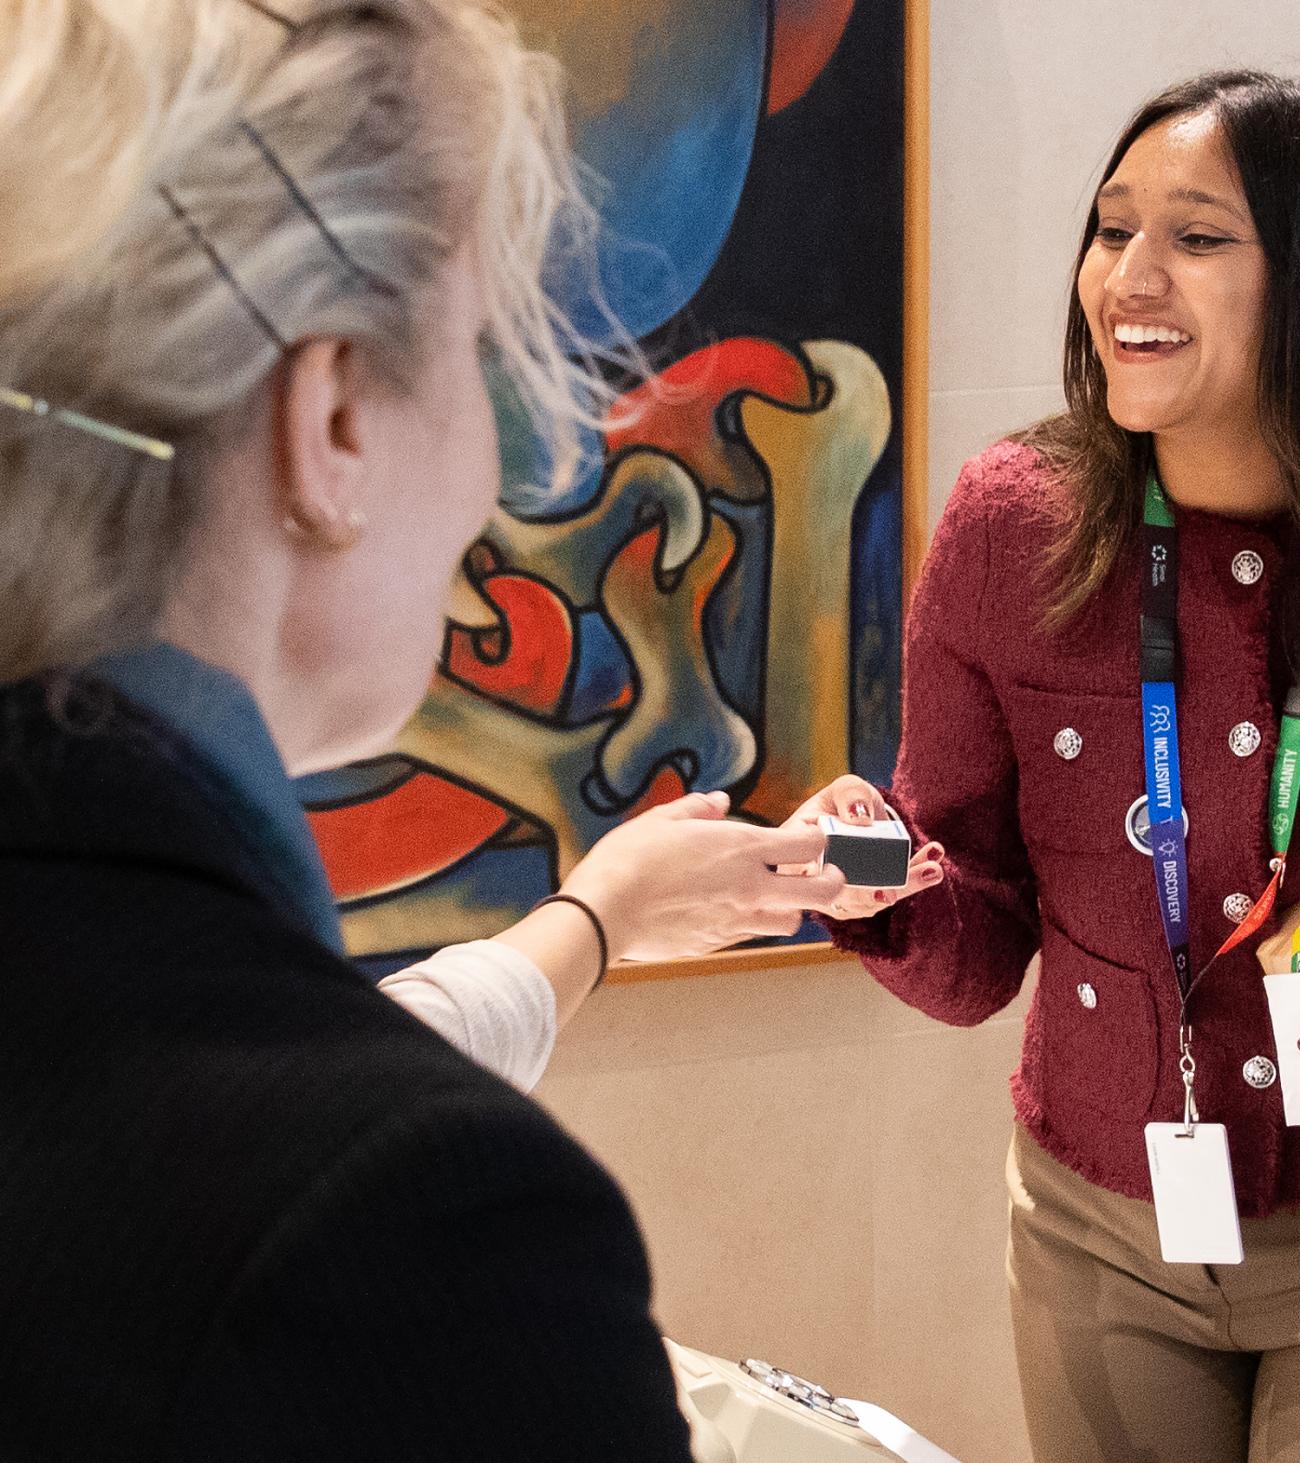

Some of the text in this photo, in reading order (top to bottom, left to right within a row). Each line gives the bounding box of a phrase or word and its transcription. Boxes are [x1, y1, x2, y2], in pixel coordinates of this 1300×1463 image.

[1153, 736, 1171, 809] INCLUSIVITY
[1277, 748, 1298, 809] HUMANITY
[1162, 860, 1181, 923] DISCOVERY
